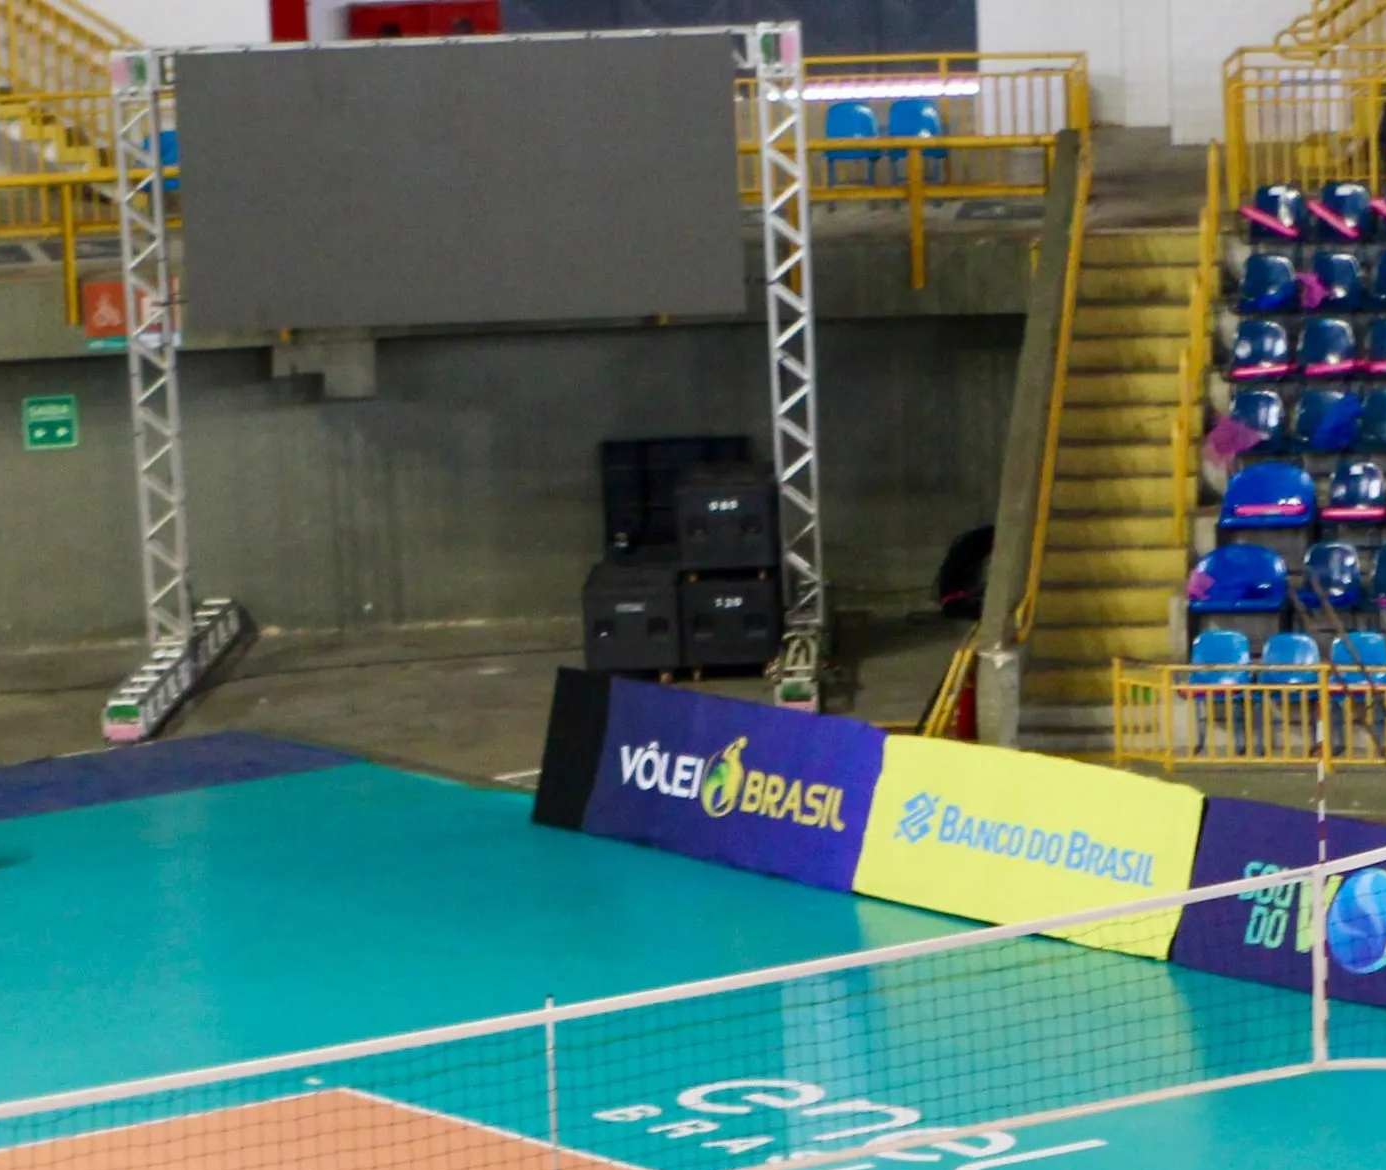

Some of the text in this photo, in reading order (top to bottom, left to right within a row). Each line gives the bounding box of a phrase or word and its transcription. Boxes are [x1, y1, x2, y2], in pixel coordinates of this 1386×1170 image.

[620, 739, 846, 833] VÔLEI BRASIL
[938, 805, 1155, 888] BANCO DO BRASIL
[1244, 904, 1288, 949] DO
